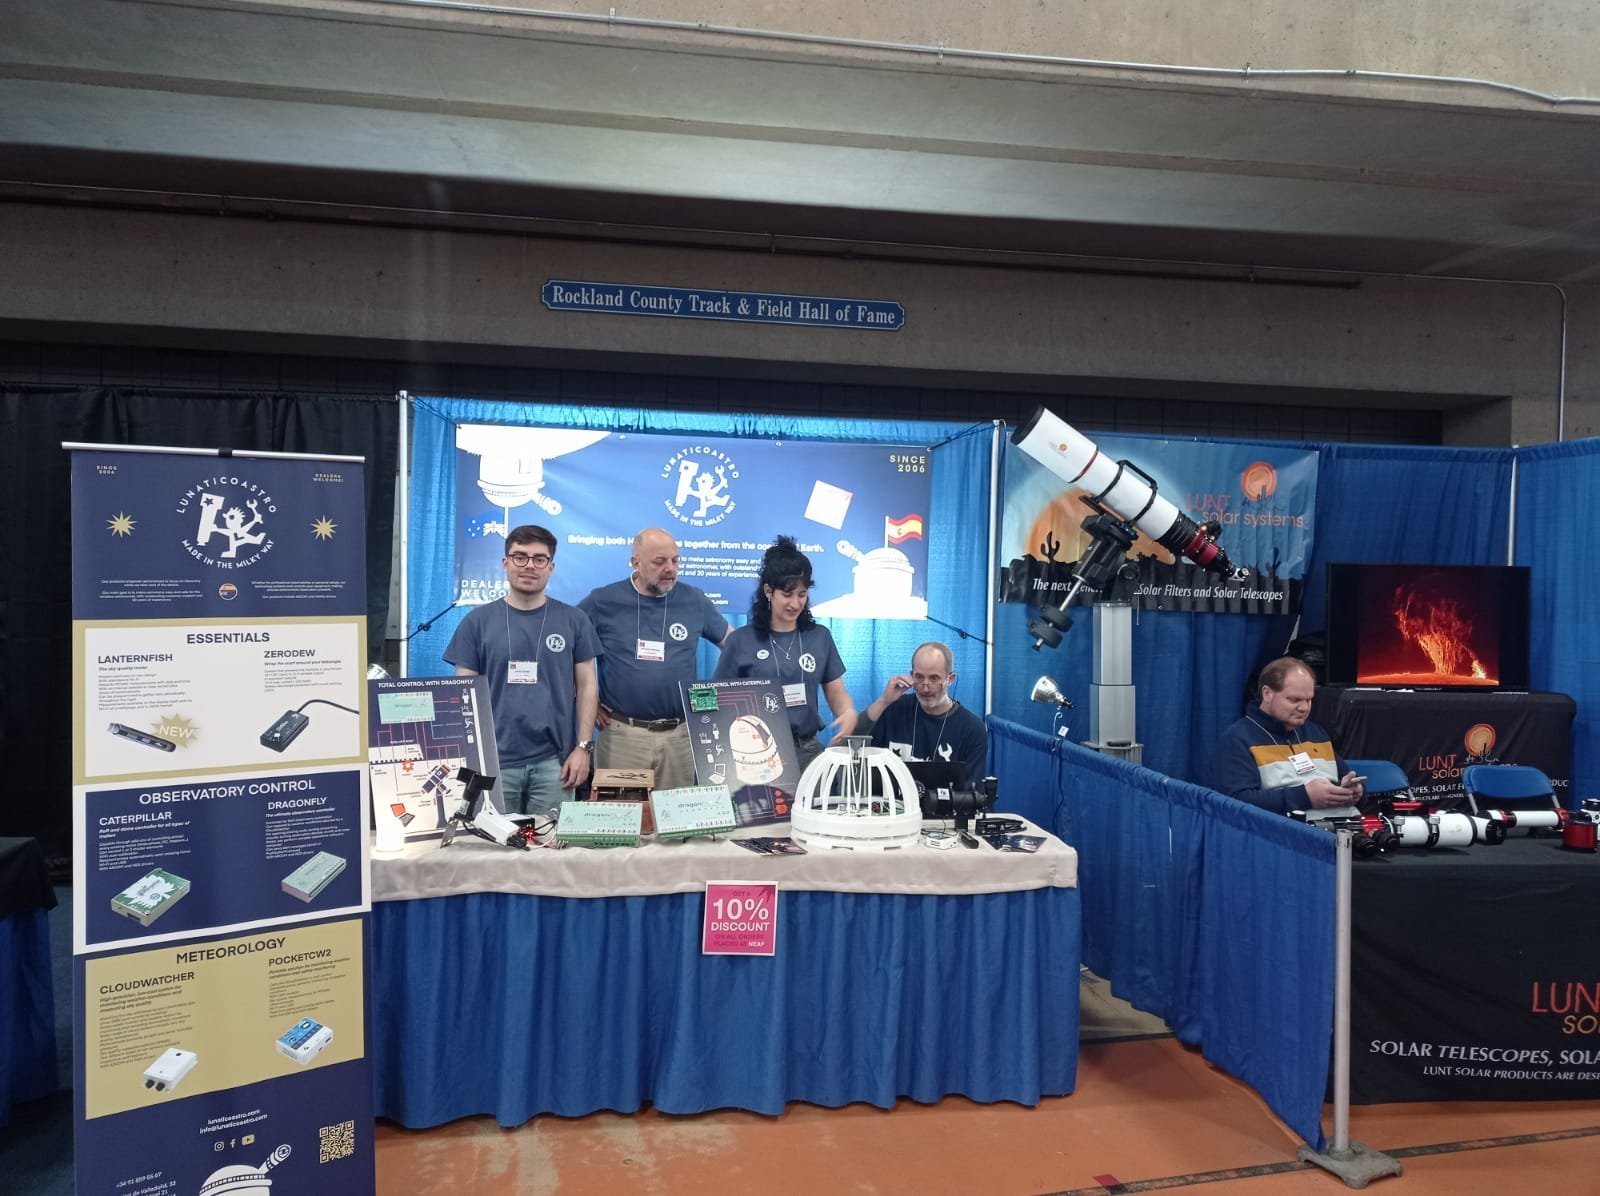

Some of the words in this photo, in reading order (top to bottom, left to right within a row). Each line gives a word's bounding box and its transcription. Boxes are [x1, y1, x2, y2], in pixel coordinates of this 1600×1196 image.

[553, 285, 623, 308] Rockland
[630, 291, 683, 313] County
[689, 295, 730, 314] Track
[737, 302, 750, 315] &
[758, 300, 792, 318] Field
[800, 302, 830, 321] Hall
[836, 304, 850, 322] of
[858, 305, 895, 324] Fame
[662, 446, 739, 479] LUNATICOASTRO
[890, 455, 926, 464] SINCE
[898, 464, 926, 473] 2006
[177, 476, 277, 514] LUNATICOASTRO
[1186, 493, 1231, 511] LUNT
[1203, 509, 1240, 525] solar
[1244, 512, 1305, 528] systems
[568, 535, 605, 545] Bringing
[606, 536, 626, 545] both
[684, 542, 719, 550] together
[720, 541, 740, 550] from
[742, 542, 756, 550] the
[181, 539, 203, 560] MADE
[204, 557, 214, 566] IN
[217, 561, 233, 569] THE
[236, 554, 261, 569] MILKY
[260, 539, 275, 554] WAY
[462, 580, 510, 589] DEALER
[1033, 578, 1048, 591] The
[1051, 581, 1072, 592] next
[1139, 583, 1162, 596] Solar
[1164, 584, 1192, 597] Filters
[1194, 588, 1211, 598] and
[1213, 587, 1238, 598] Solar
[1240, 587, 1283, 603] Telescopes
[461, 590, 509, 598] WELCO
[187, 632, 270, 644] ESSENTIALS
[98, 653, 173, 664] LANTERNFISH
[264, 649, 315, 659] ZERODEW
[397, 680, 425, 688] CONTROL
[159, 725, 193, 738] NEW
[1419, 754, 1456, 771] LUNT
[1432, 766, 1465, 779] solar
[139, 786, 246, 805] OBSERVATORY
[249, 779, 316, 795] CONTROL
[1432, 783, 1457, 793] SOLAR
[268, 797, 327, 810] DRAGONFLY
[99, 811, 172, 826] CATERPILLAR
[713, 898, 769, 920] 10%
[711, 922, 770, 931] DISCOUNT
[176, 937, 286, 964] METEOROLOGY
[269, 948, 331, 967] POCKETCW2
[100, 971, 195, 995] CLOUDWATCHER
[1370, 1039, 1433, 1057] SOLAR
[1438, 1045, 1553, 1066] TELESCOPES,
[1560, 1049, 1600, 1065] SOLA
[1423, 1066, 1452, 1076] LUNT
[1455, 1067, 1491, 1078] SOLAR
[1494, 1070, 1553, 1081] PRODUCTS
[1555, 1072, 1574, 1080] ARE
